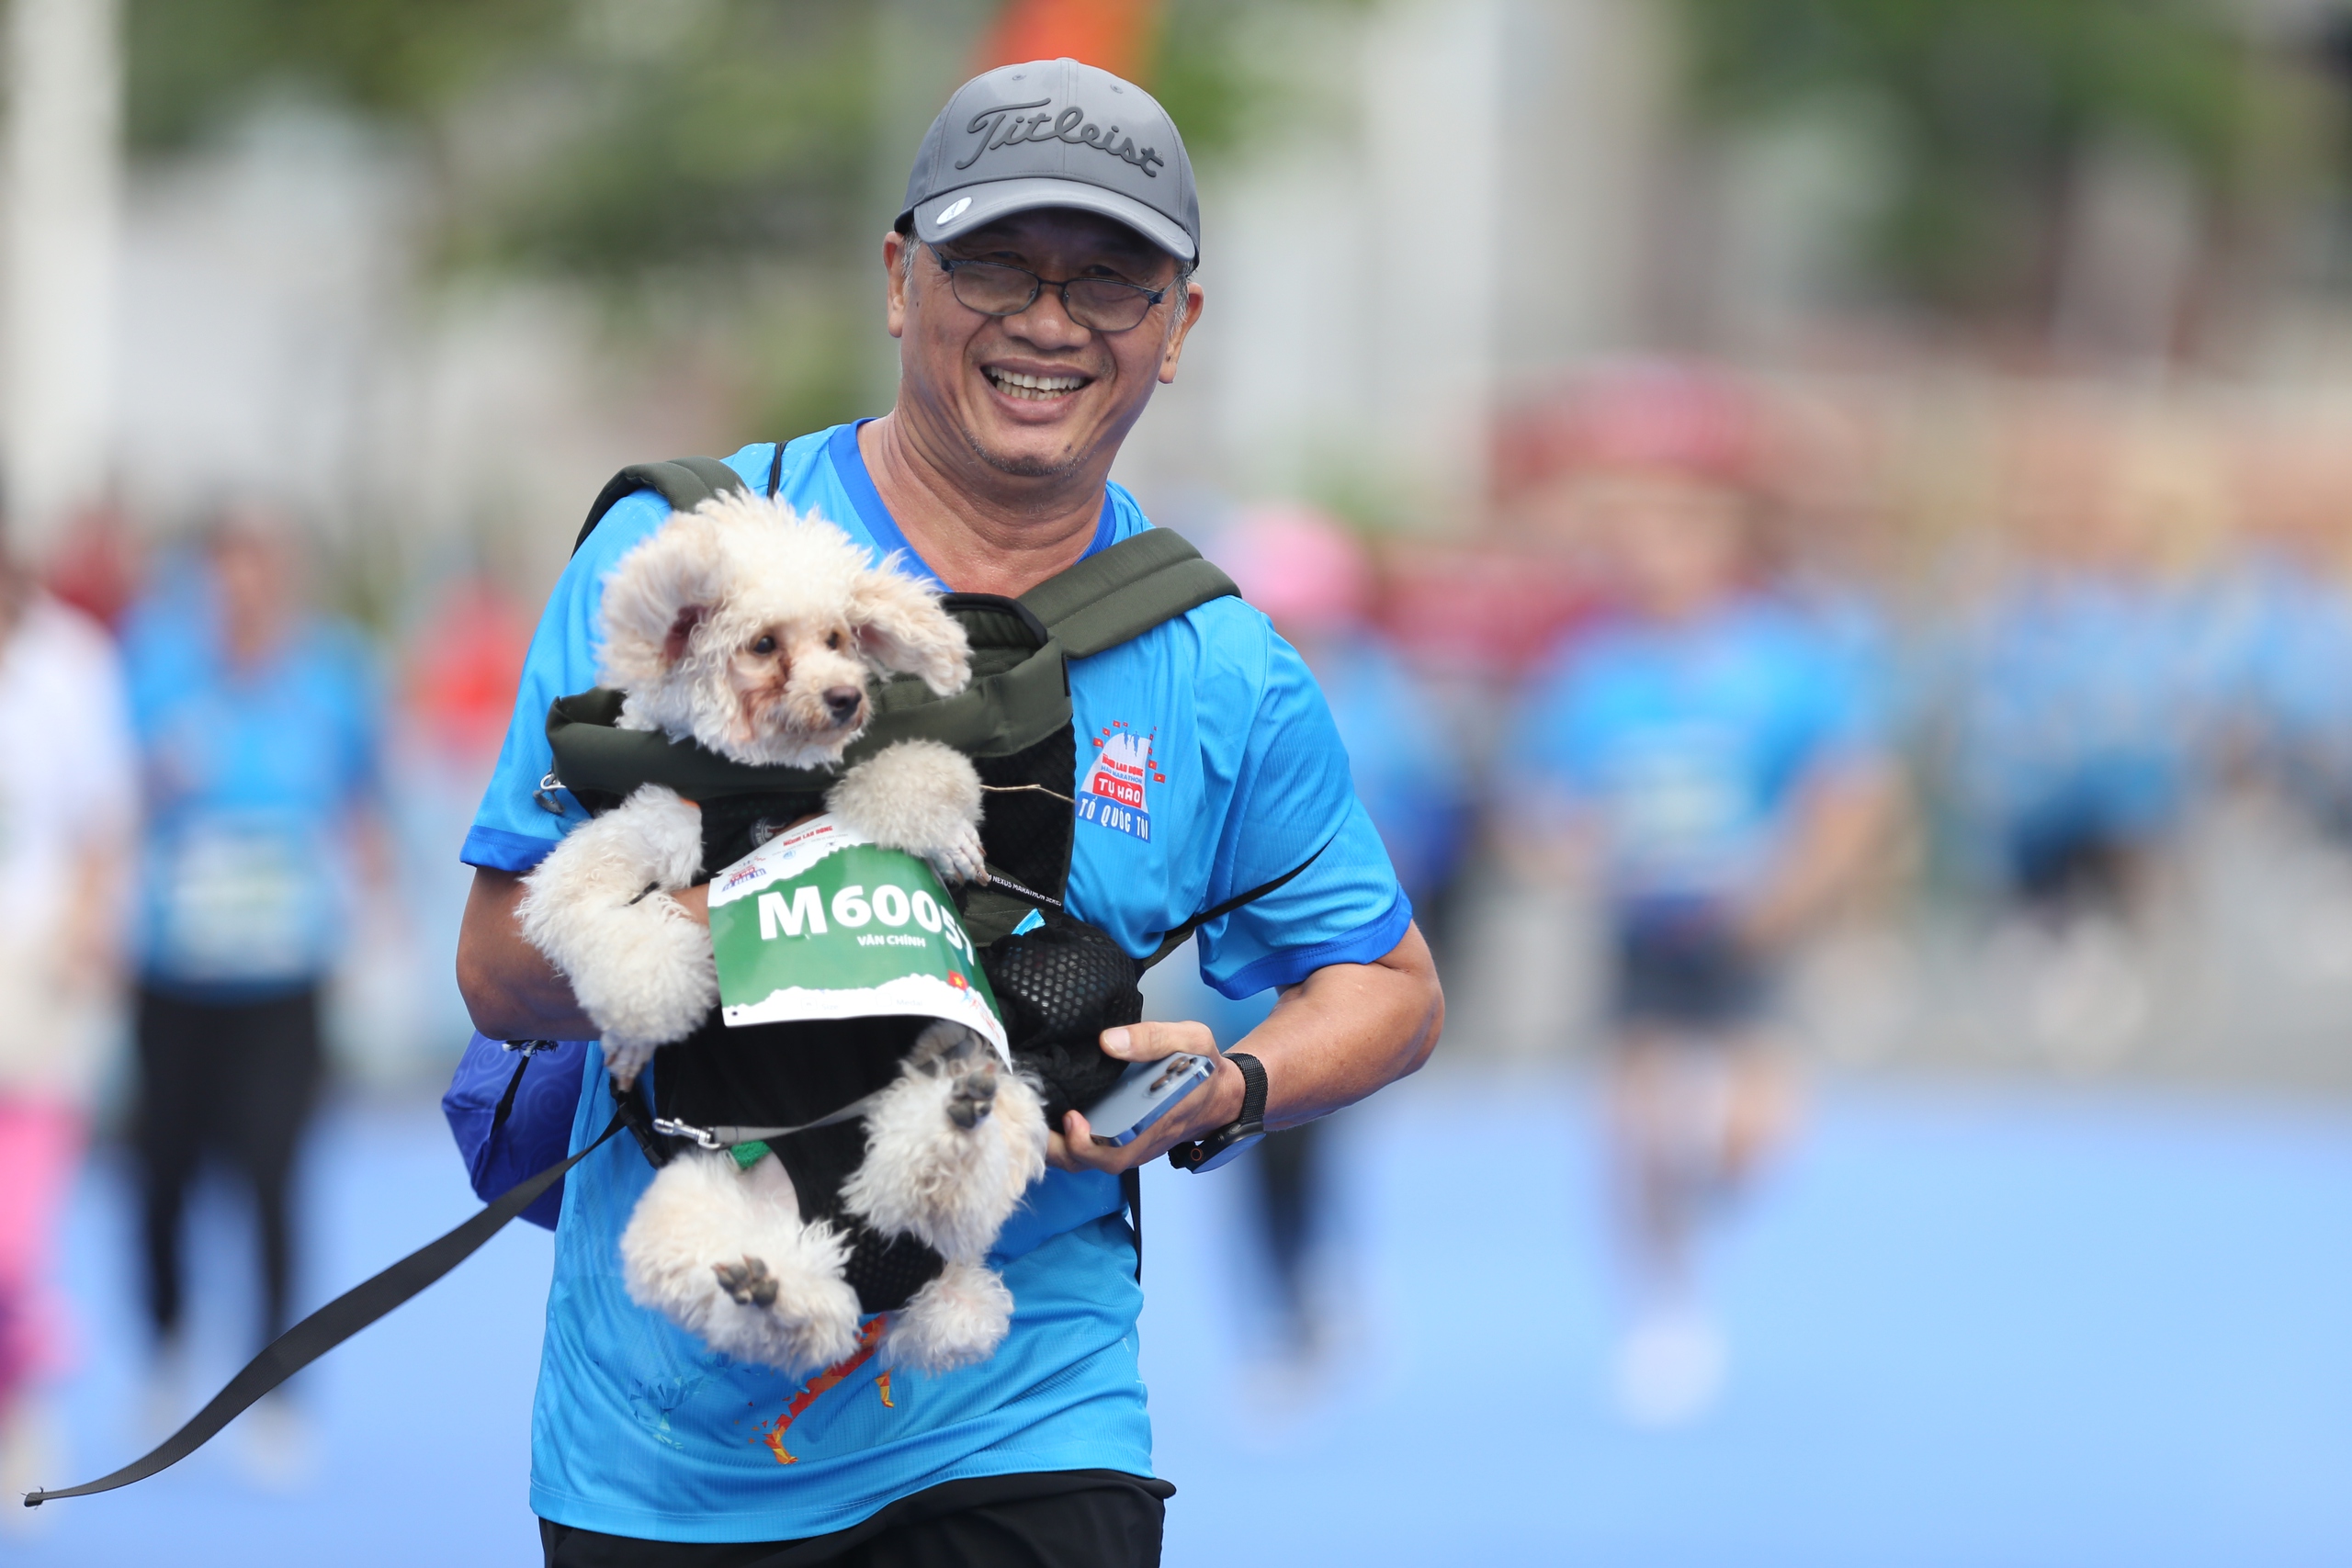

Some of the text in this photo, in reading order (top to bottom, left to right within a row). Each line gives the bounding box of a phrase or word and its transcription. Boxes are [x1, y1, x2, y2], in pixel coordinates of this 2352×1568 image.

[955, 97, 1165, 178] Titleist
[1098, 778, 1141, 804] TỰ HÀO
[1078, 796, 1149, 840] TỔ QUỐC TÔI
[992, 875, 1012, 888] NEXUS
[1012, 883, 1046, 901] MARATHON
[886, 933, 926, 948] CHÍNH
